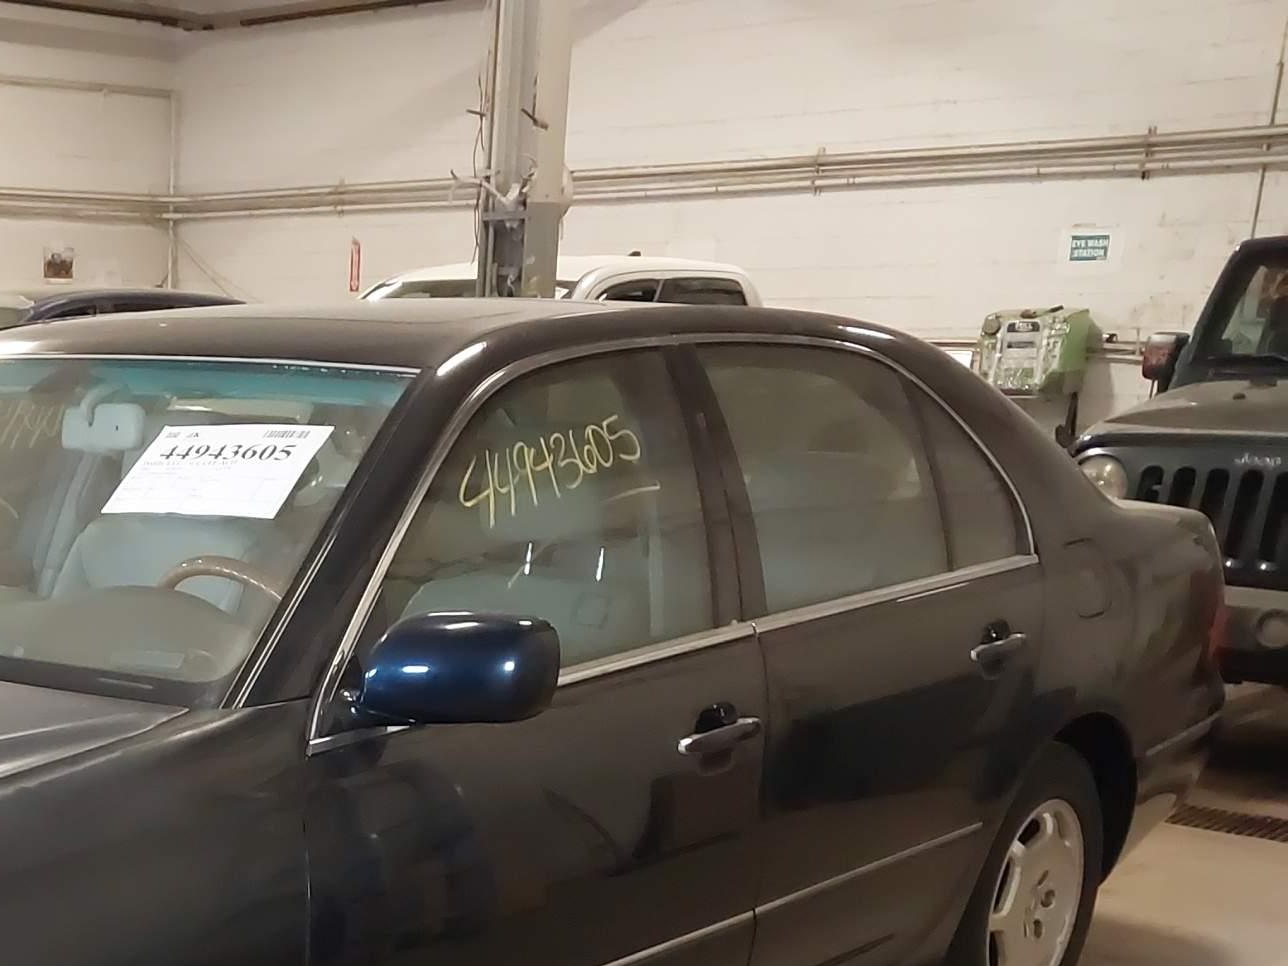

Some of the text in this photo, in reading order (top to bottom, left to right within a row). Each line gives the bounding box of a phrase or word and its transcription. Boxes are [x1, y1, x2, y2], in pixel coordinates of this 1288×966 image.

[1072, 248, 1105, 257] STATION
[159, 443, 298, 461] 44943605
[458, 414, 642, 529] 44943605
